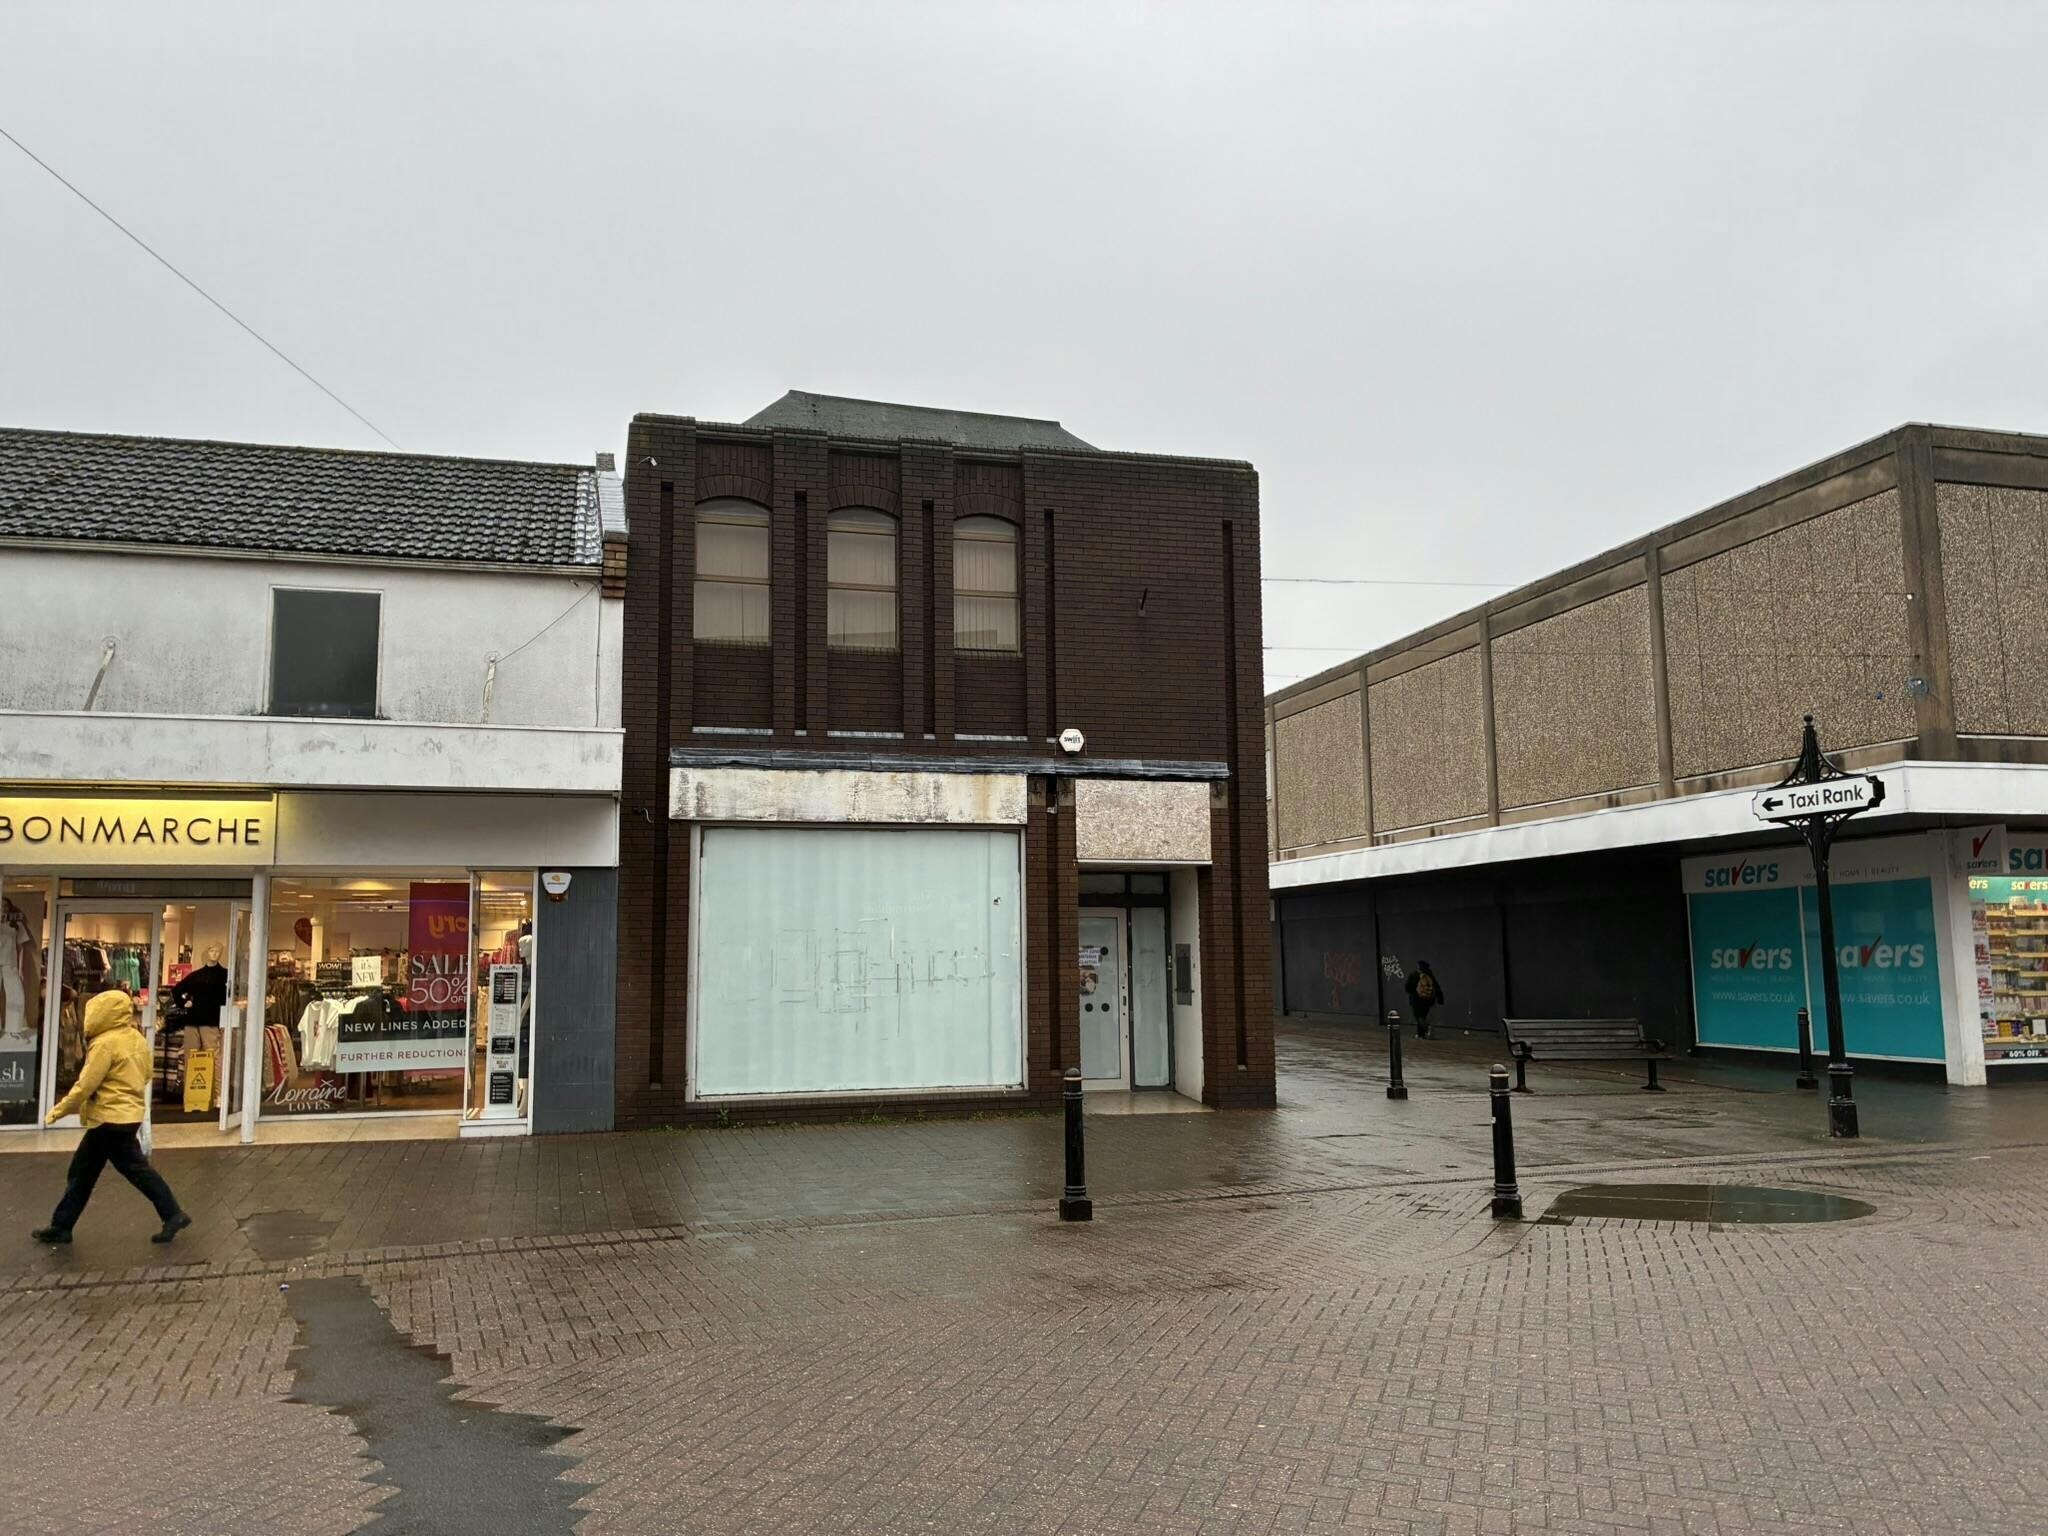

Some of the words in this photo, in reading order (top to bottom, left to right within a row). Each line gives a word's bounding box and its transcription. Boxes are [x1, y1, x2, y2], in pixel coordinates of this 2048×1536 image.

[1788, 791, 1820, 809] Taxi
[1822, 784, 1864, 805] Rank
[0, 815, 261, 845] BONMARCHE
[1967, 859, 1998, 870] savers
[2008, 847, 2048, 871] sa
[1704, 856, 1779, 888] savers
[1710, 938, 1793, 970] savers
[355, 971, 376, 984] NEW
[410, 977, 468, 1004] 50%
[1711, 991, 1799, 1004] www.savers.co.uk
[344, 1022, 375, 1032] NEW
[380, 1021, 418, 1031] LINES
[422, 1019, 466, 1030] ADDED
[340, 1051, 393, 1062] FURTHER
[397, 1048, 466, 1060] REDUCTION
[264, 1075, 346, 1105] Lorraine
[288, 1101, 331, 1112] LOVES
